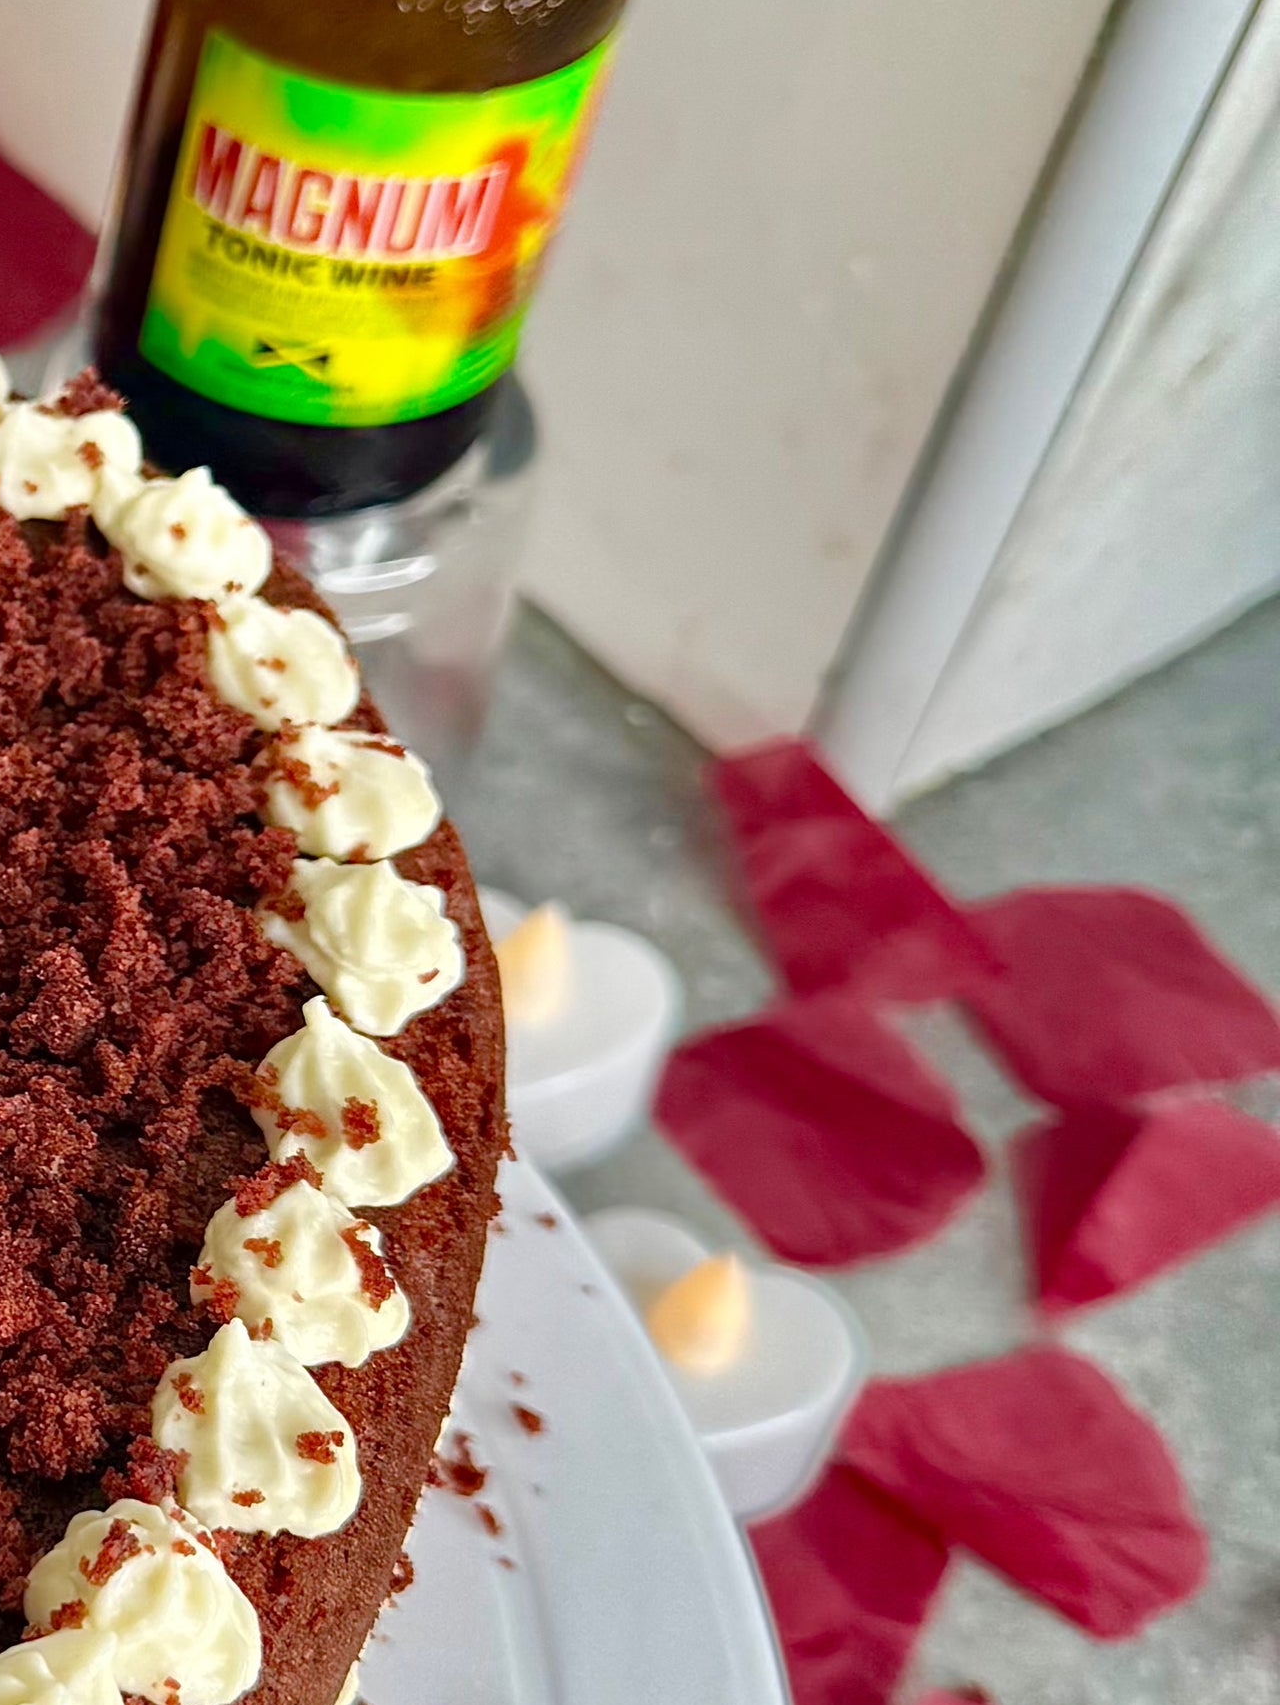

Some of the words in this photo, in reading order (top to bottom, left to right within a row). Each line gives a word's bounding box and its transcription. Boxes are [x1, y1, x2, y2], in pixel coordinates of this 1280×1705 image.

[194, 122, 509, 260] MAGNUM
[205, 221, 317, 282] TONIC
[328, 261, 436, 289] WINE
